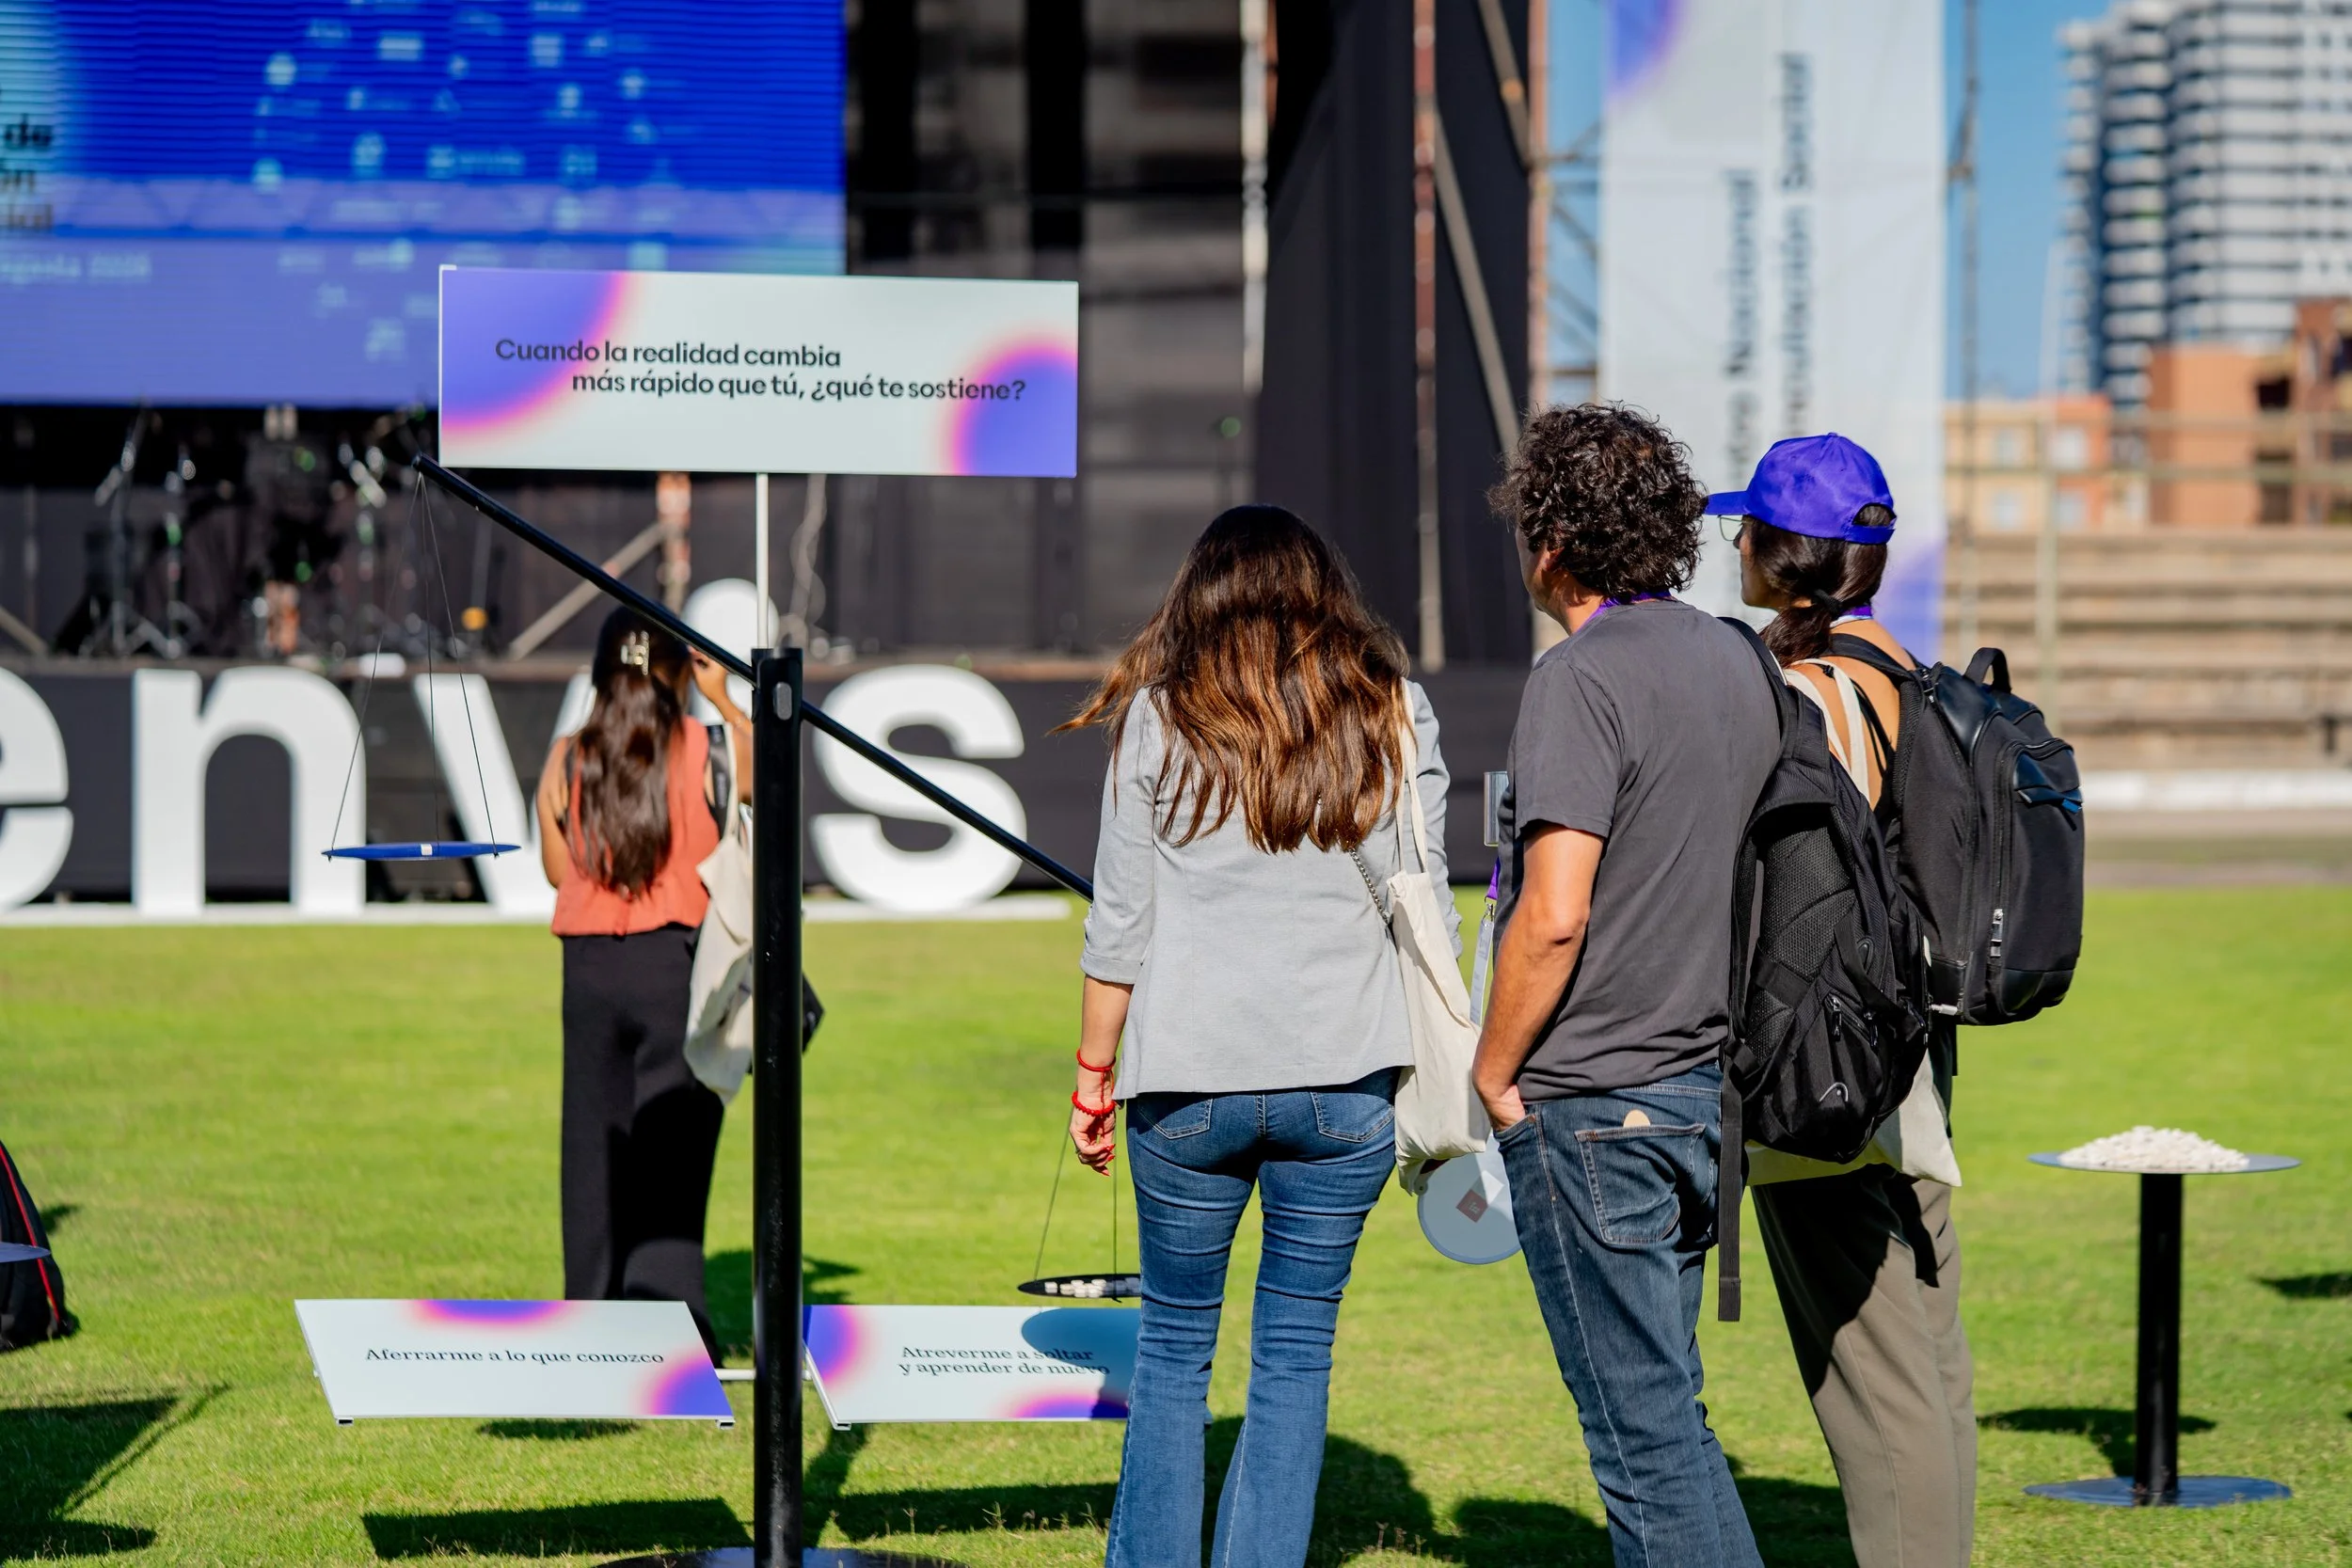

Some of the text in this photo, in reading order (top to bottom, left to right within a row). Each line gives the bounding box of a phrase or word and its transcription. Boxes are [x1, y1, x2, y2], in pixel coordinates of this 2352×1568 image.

[495, 339, 841, 367] Cuando la realidad cambia
[572, 369, 1026, 402] más rápido que tú, ¿qué te sostiene?
[365, 1348, 664, 1366] Aferrarme a lo que conozco
[901, 1346, 1095, 1362] Atreverme a soltar
[898, 1361, 1112, 1377] y aprender de nuevo
